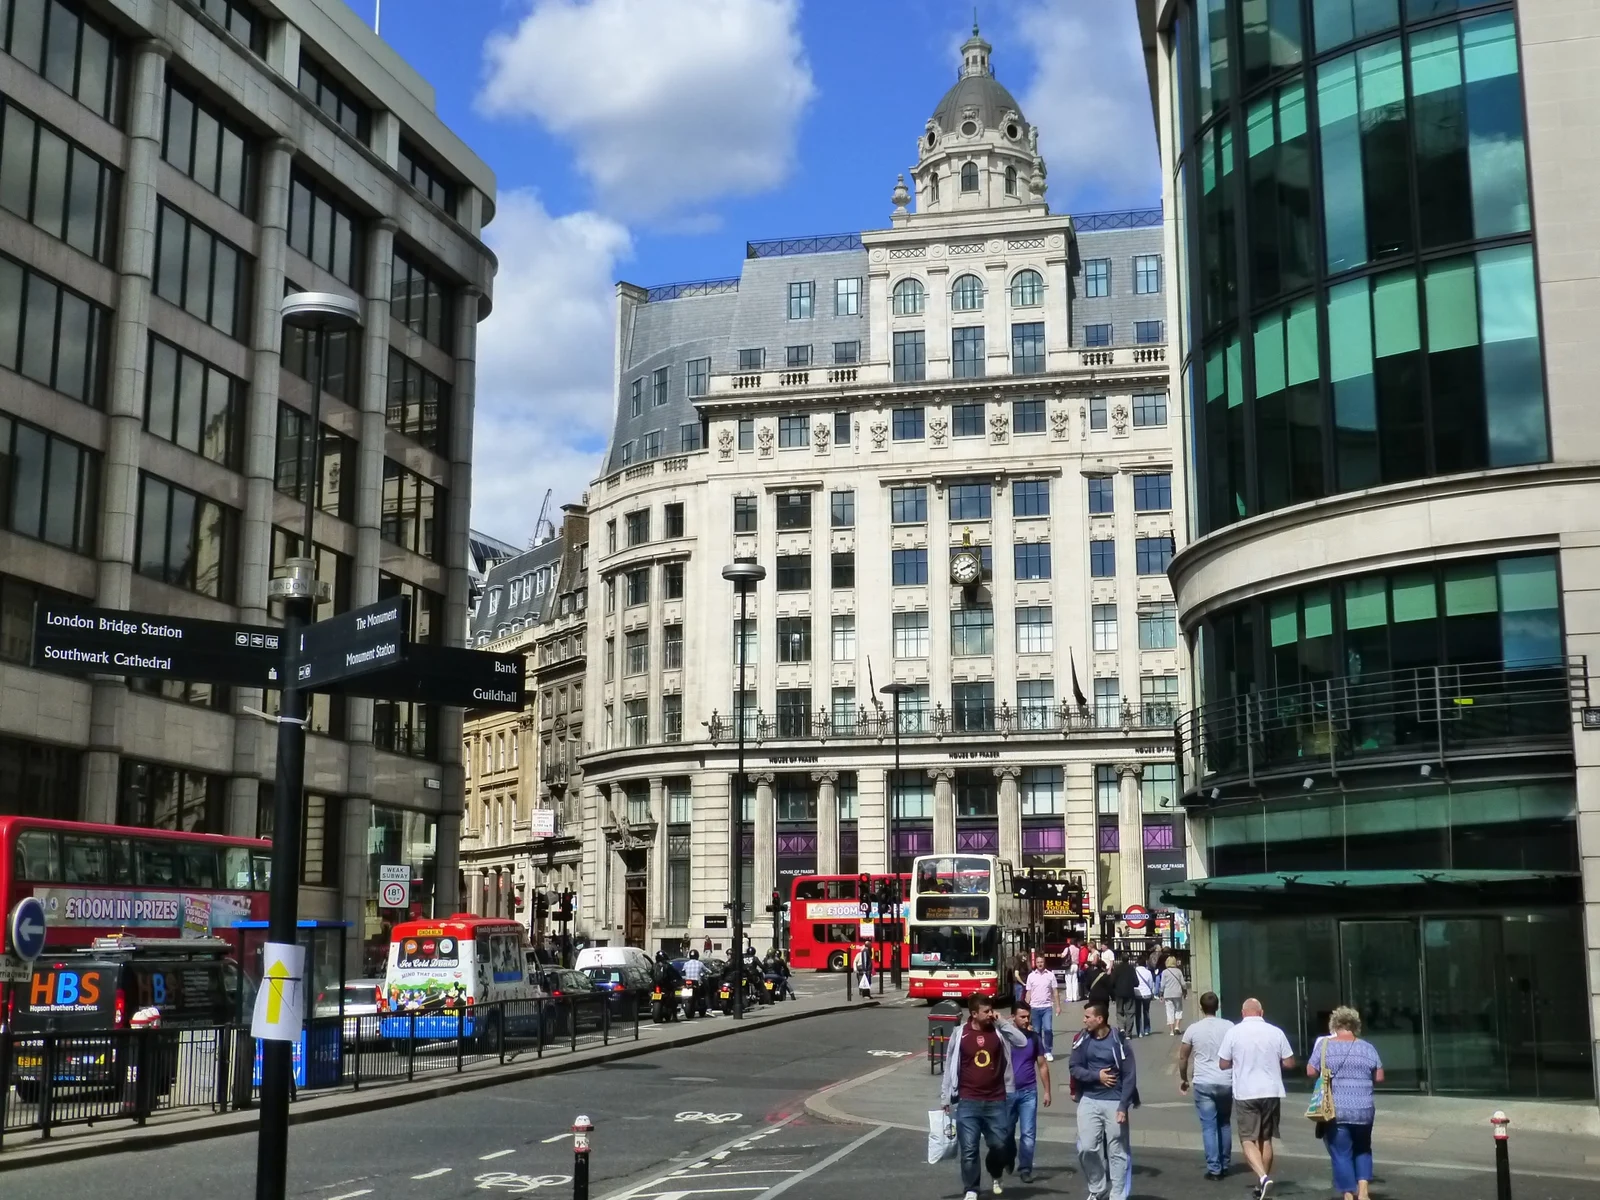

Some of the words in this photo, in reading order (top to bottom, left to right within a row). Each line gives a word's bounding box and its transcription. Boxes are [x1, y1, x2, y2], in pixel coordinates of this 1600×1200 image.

[46, 611, 94, 630] London
[99, 617, 138, 635] Bridge
[141, 622, 183, 639] Station
[356, 617, 366, 631] The
[367, 608, 397, 628] Monument
[44, 646, 109, 664] Southwark
[113, 652, 171, 670] Cathedral
[346, 648, 375, 667] Monument
[376, 643, 396, 659] Station
[494, 660, 518, 674] Bank
[472, 687, 517, 703] Guildhall
[65, 898, 114, 920] £100M
[116, 900, 132, 919] IN
[134, 901, 179, 920] PRIZES
[827, 907, 858, 915] £100M
[400, 959, 411, 968] Ice
[412, 958, 429, 967] Cold
[401, 971, 415, 979] MIND
[30, 972, 100, 1005] HBS
[30, 1005, 50, 1013] Hopson
[51, 1004, 74, 1012] Brothers
